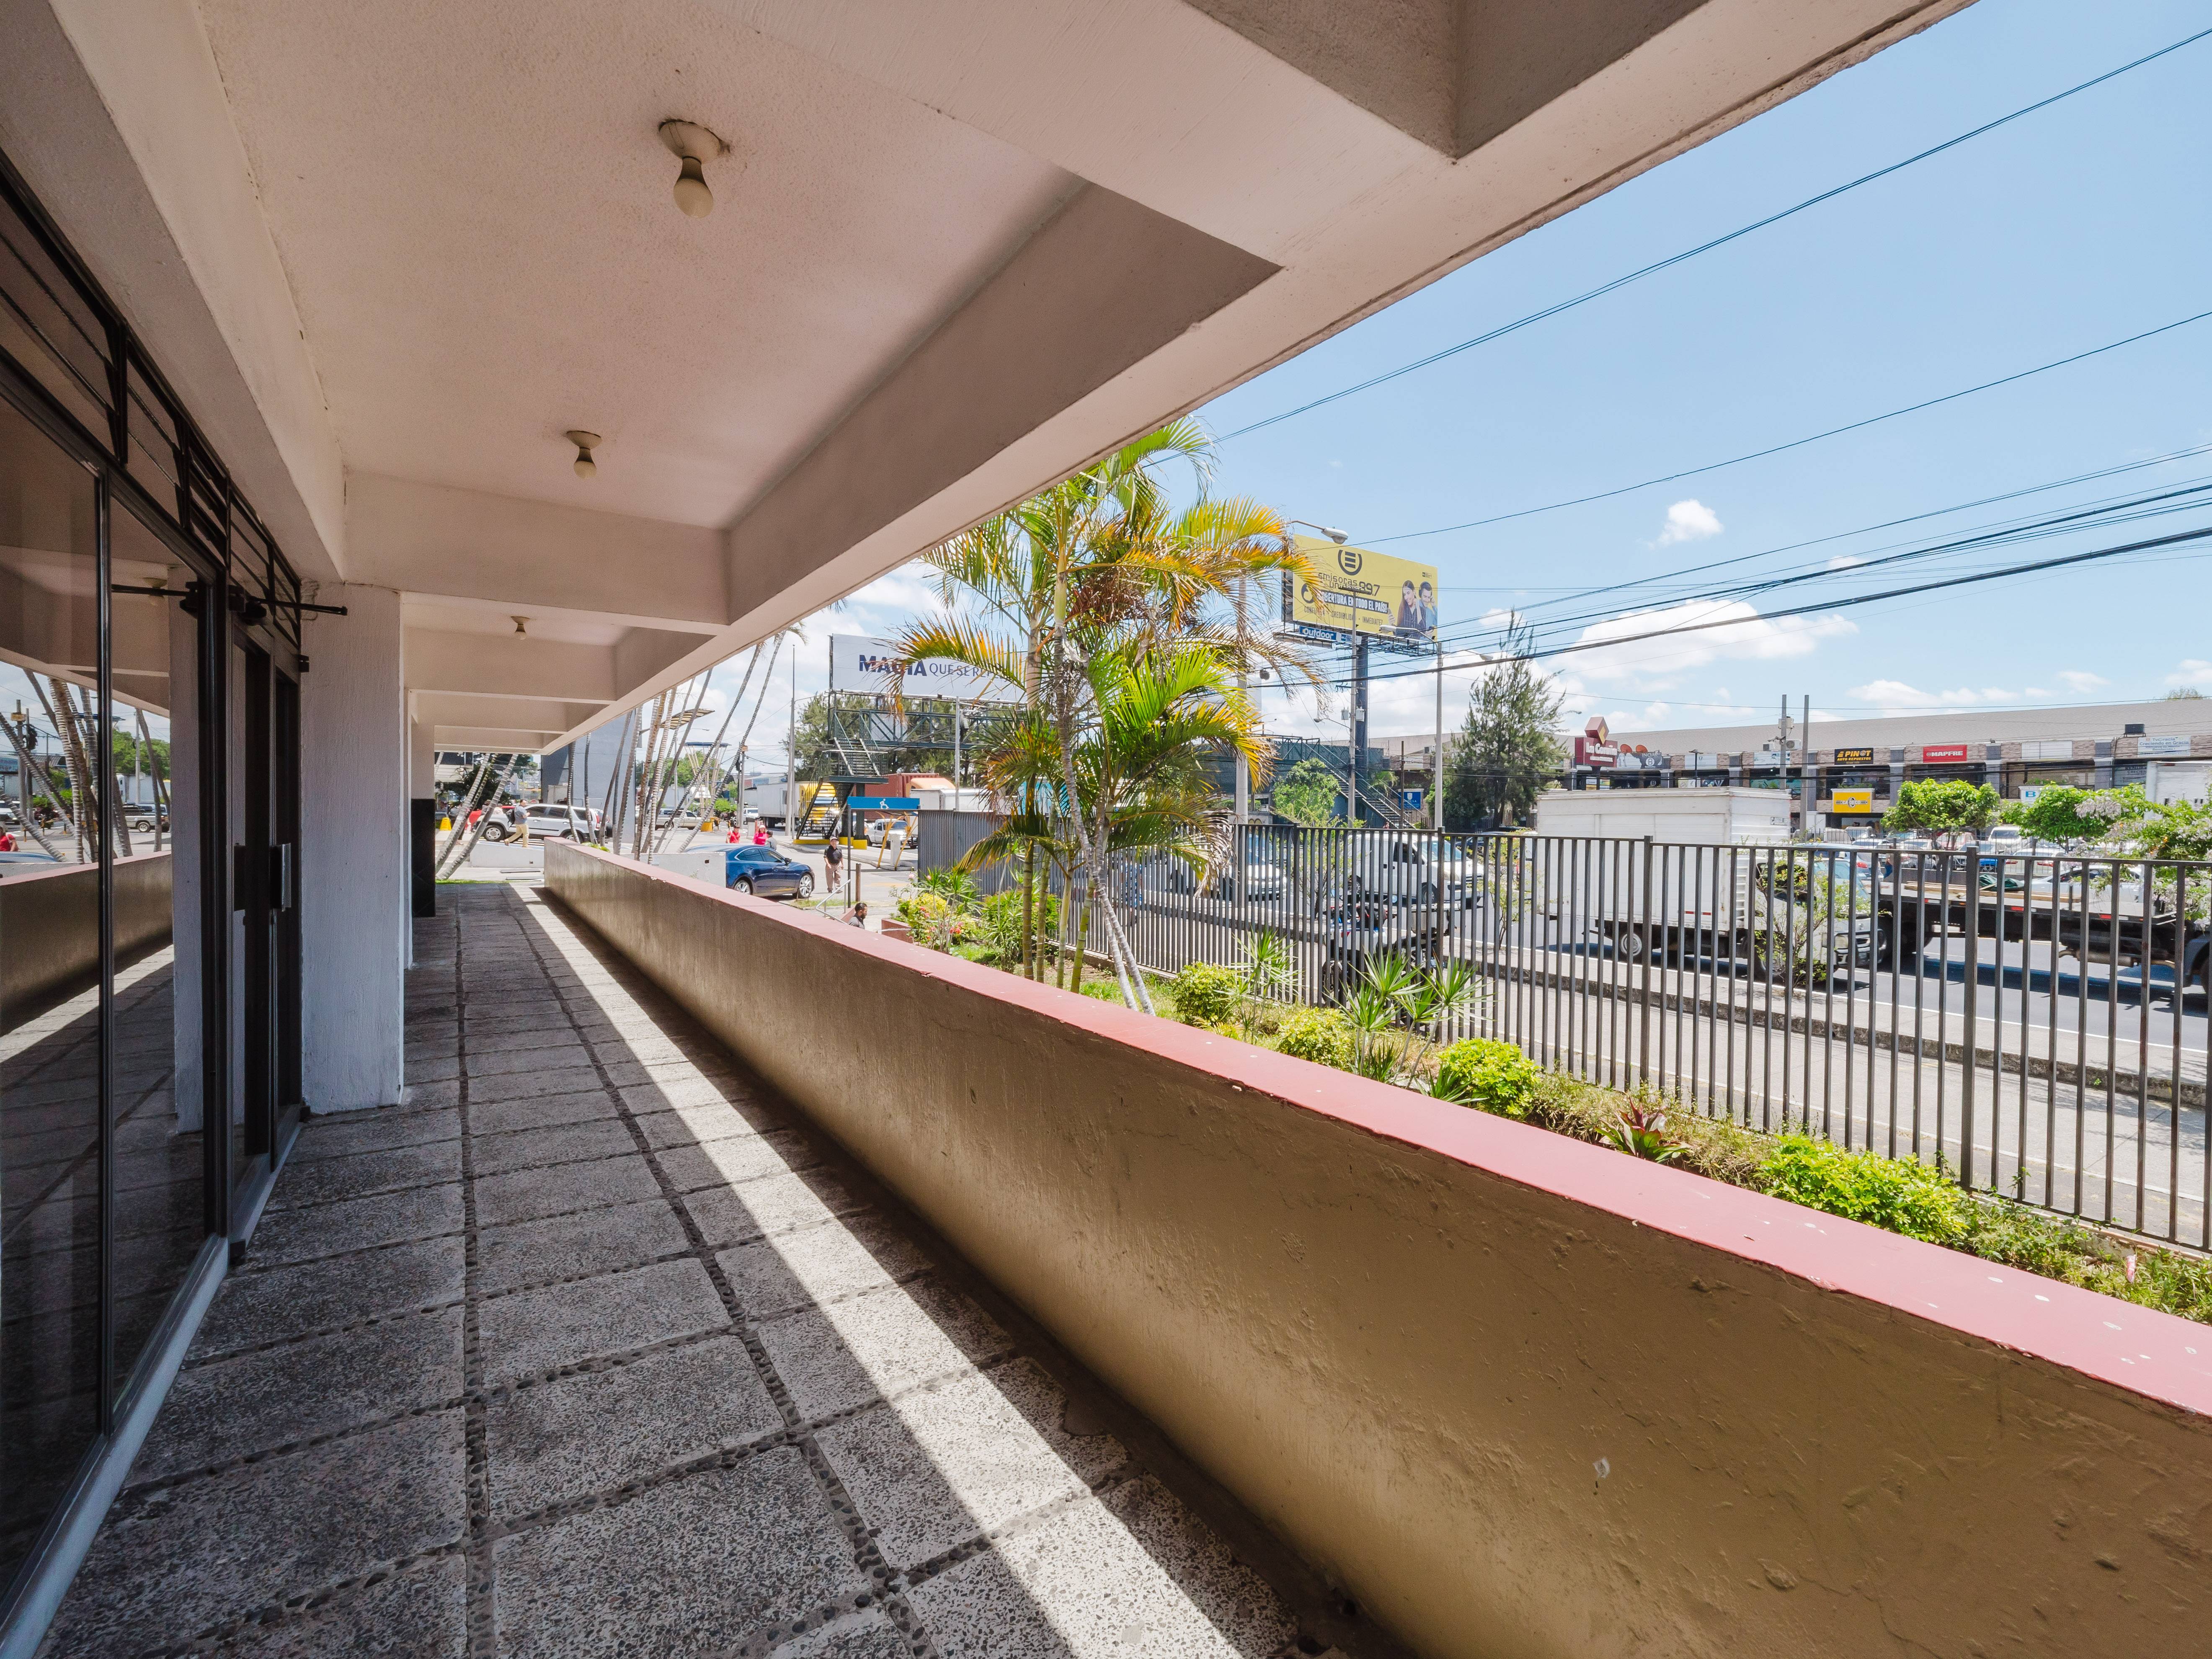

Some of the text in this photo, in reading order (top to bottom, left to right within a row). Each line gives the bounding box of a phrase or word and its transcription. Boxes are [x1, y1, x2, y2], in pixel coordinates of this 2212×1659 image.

[1318, 573, 1357, 586] emisoras
[1355, 598, 1368, 609] TODO
[1368, 600, 1374, 610] EL
[1375, 601, 1387, 613] PAÍS!
[1363, 616, 1383, 626] INMEDIATEZ
[1303, 627, 1334, 639] Outdoor
[929, 663, 954, 677] QUE
[956, 665, 970, 676] SE
